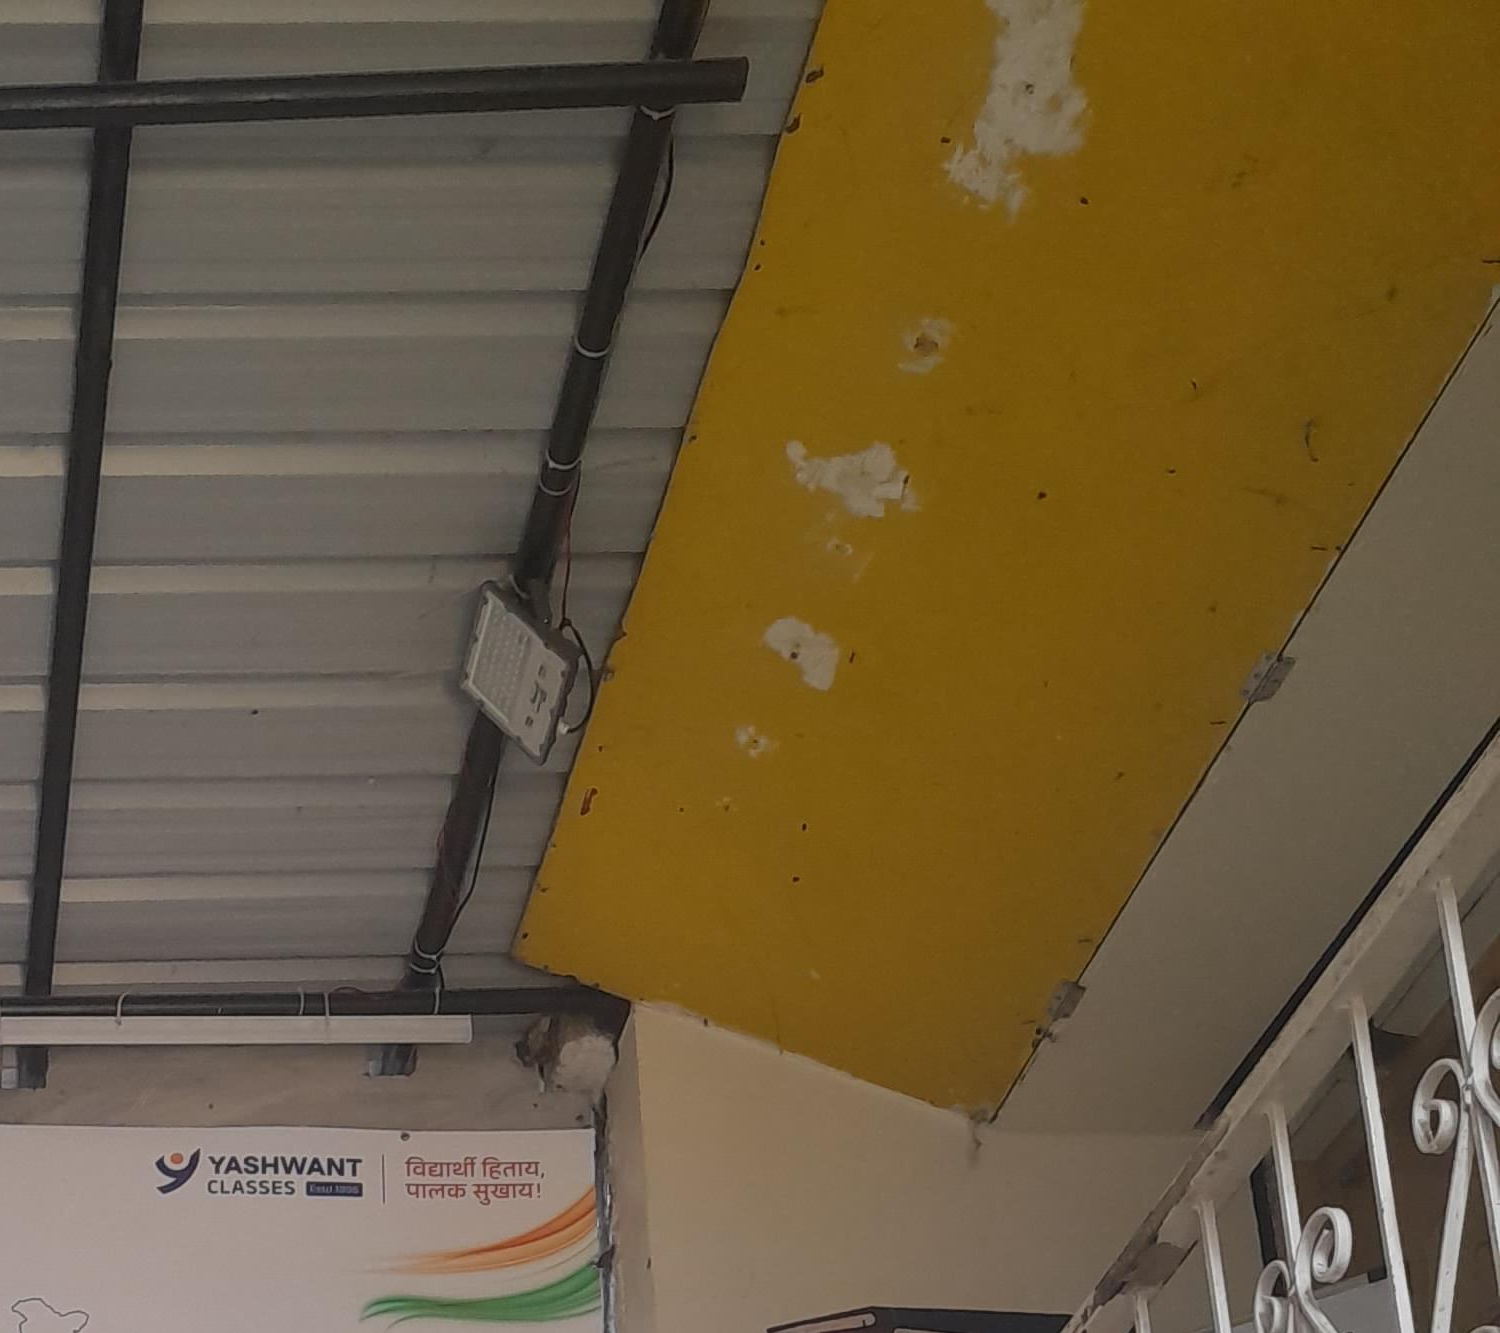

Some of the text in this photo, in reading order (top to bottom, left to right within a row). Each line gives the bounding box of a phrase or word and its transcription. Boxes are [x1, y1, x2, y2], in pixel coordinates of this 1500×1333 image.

[208, 1155, 363, 1177] YASHWANT
[404, 1155, 546, 1180] विद्यार्थी हिताय,
[207, 1180, 295, 1195] CLASSES
[405, 1183, 541, 1205] पालक सुखाय!
